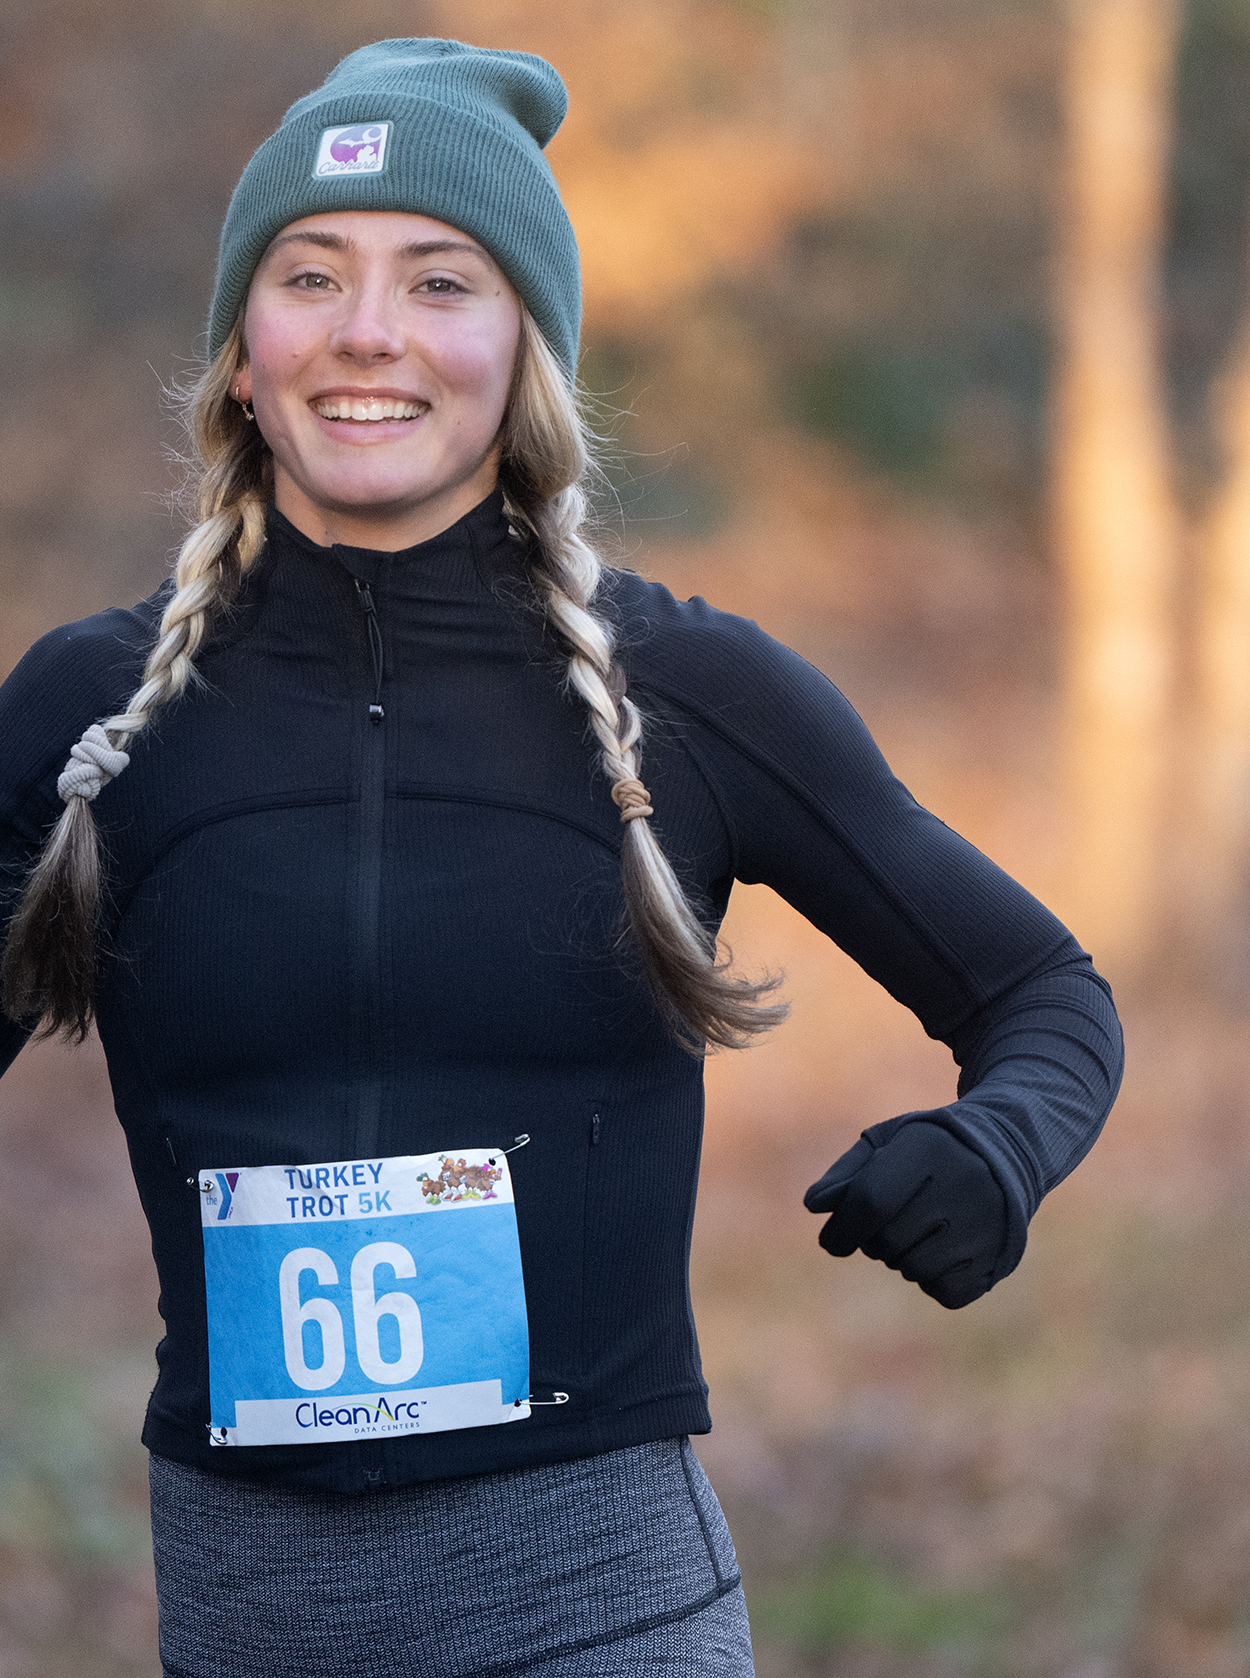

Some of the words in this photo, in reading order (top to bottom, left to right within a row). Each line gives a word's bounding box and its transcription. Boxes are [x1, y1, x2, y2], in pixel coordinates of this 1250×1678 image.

[284, 1162, 383, 1190] TURKEY
[206, 1196, 218, 1206] the
[286, 1194, 349, 1218] TROT
[358, 1190, 393, 1214] 5K
[279, 1241, 424, 1391] 66
[381, 1421, 420, 1432] CENTERS
